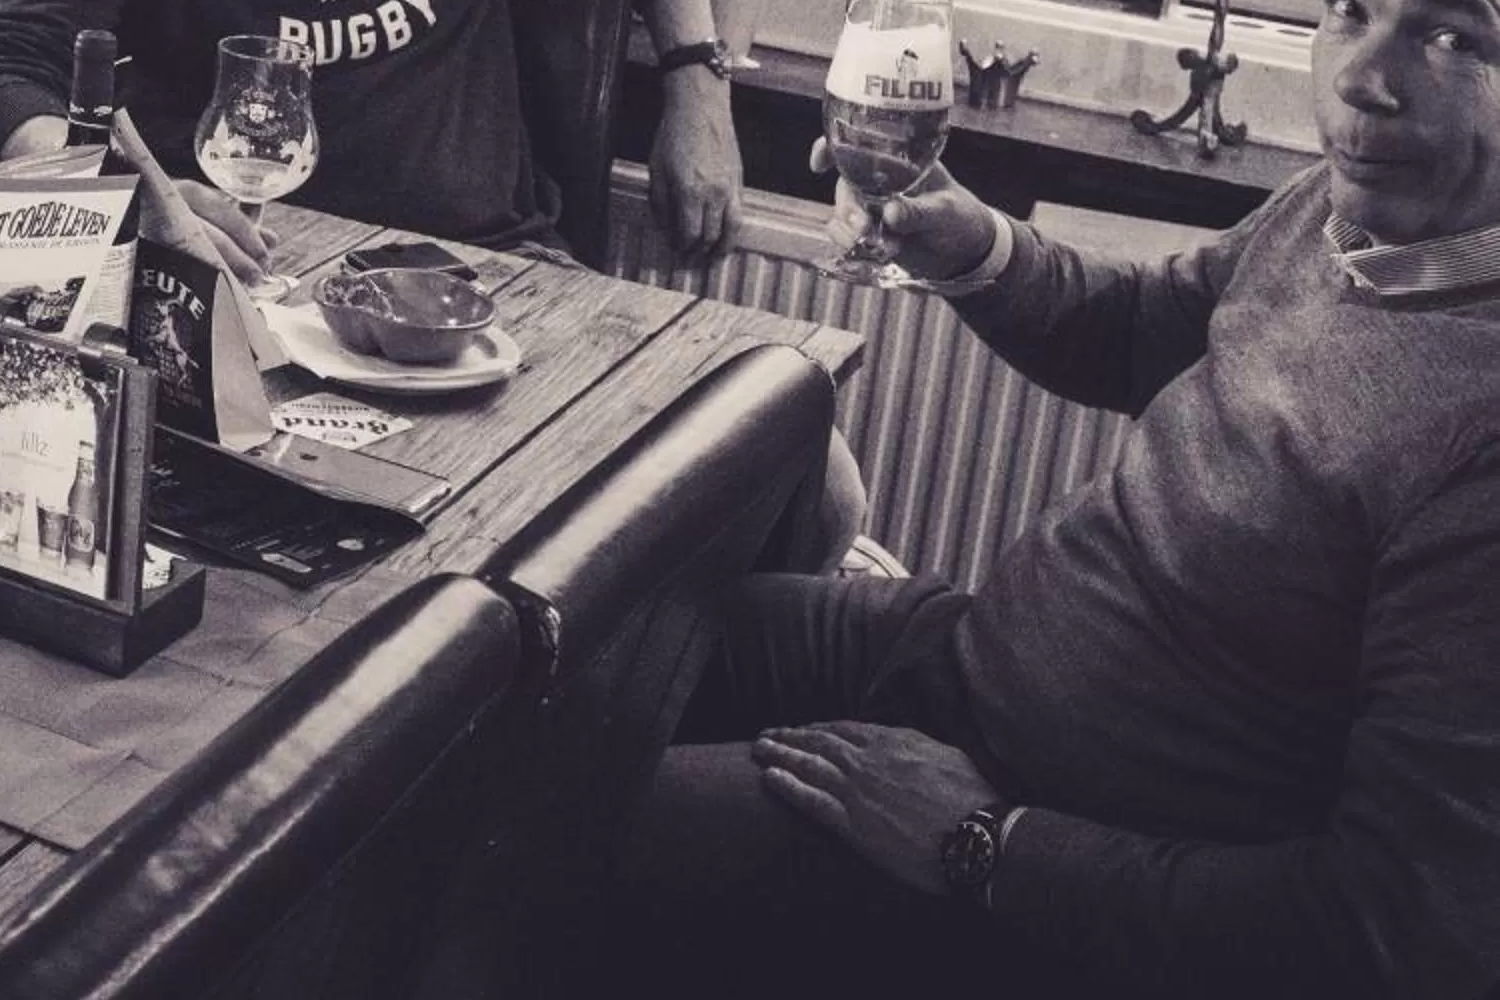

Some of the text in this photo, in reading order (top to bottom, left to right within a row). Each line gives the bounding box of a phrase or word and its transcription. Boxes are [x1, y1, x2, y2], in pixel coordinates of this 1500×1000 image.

[864, 74, 943, 101] FILOU
[7, 201, 67, 239] GOEDE
[59, 206, 112, 238] LEVEN
[142, 268, 206, 321] EUTE
[283, 415, 389, 436] Brand
